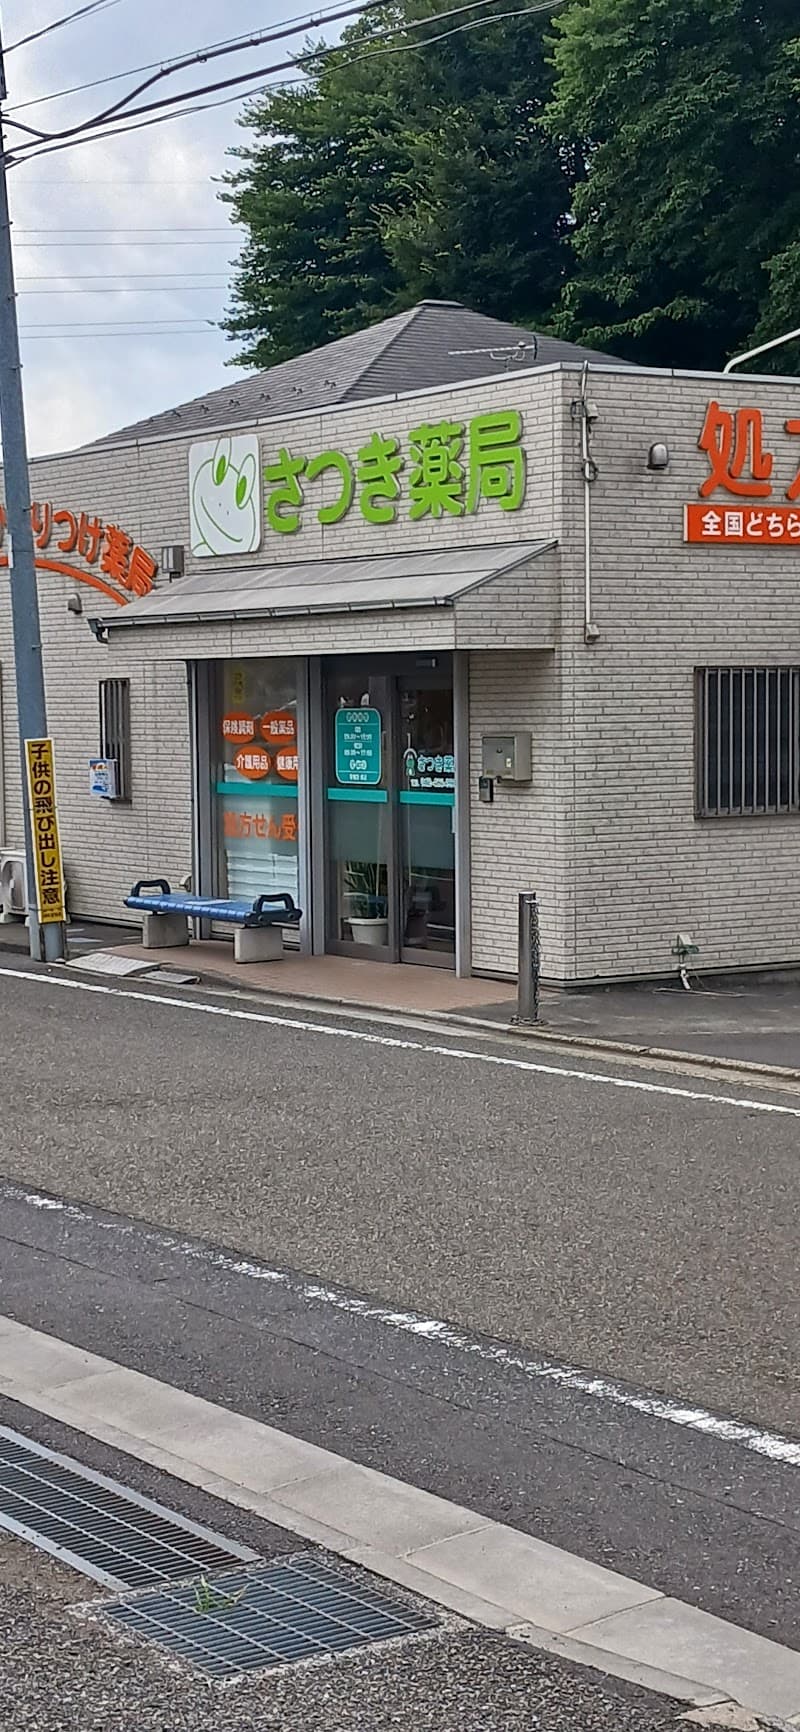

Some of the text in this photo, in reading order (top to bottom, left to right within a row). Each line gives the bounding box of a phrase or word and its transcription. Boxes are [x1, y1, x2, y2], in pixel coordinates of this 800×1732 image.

[264, 409, 526, 535] さつき薬局
[698, 400, 800, 500] 処
[31, 743, 60, 905] 子供の飛び出し注意
